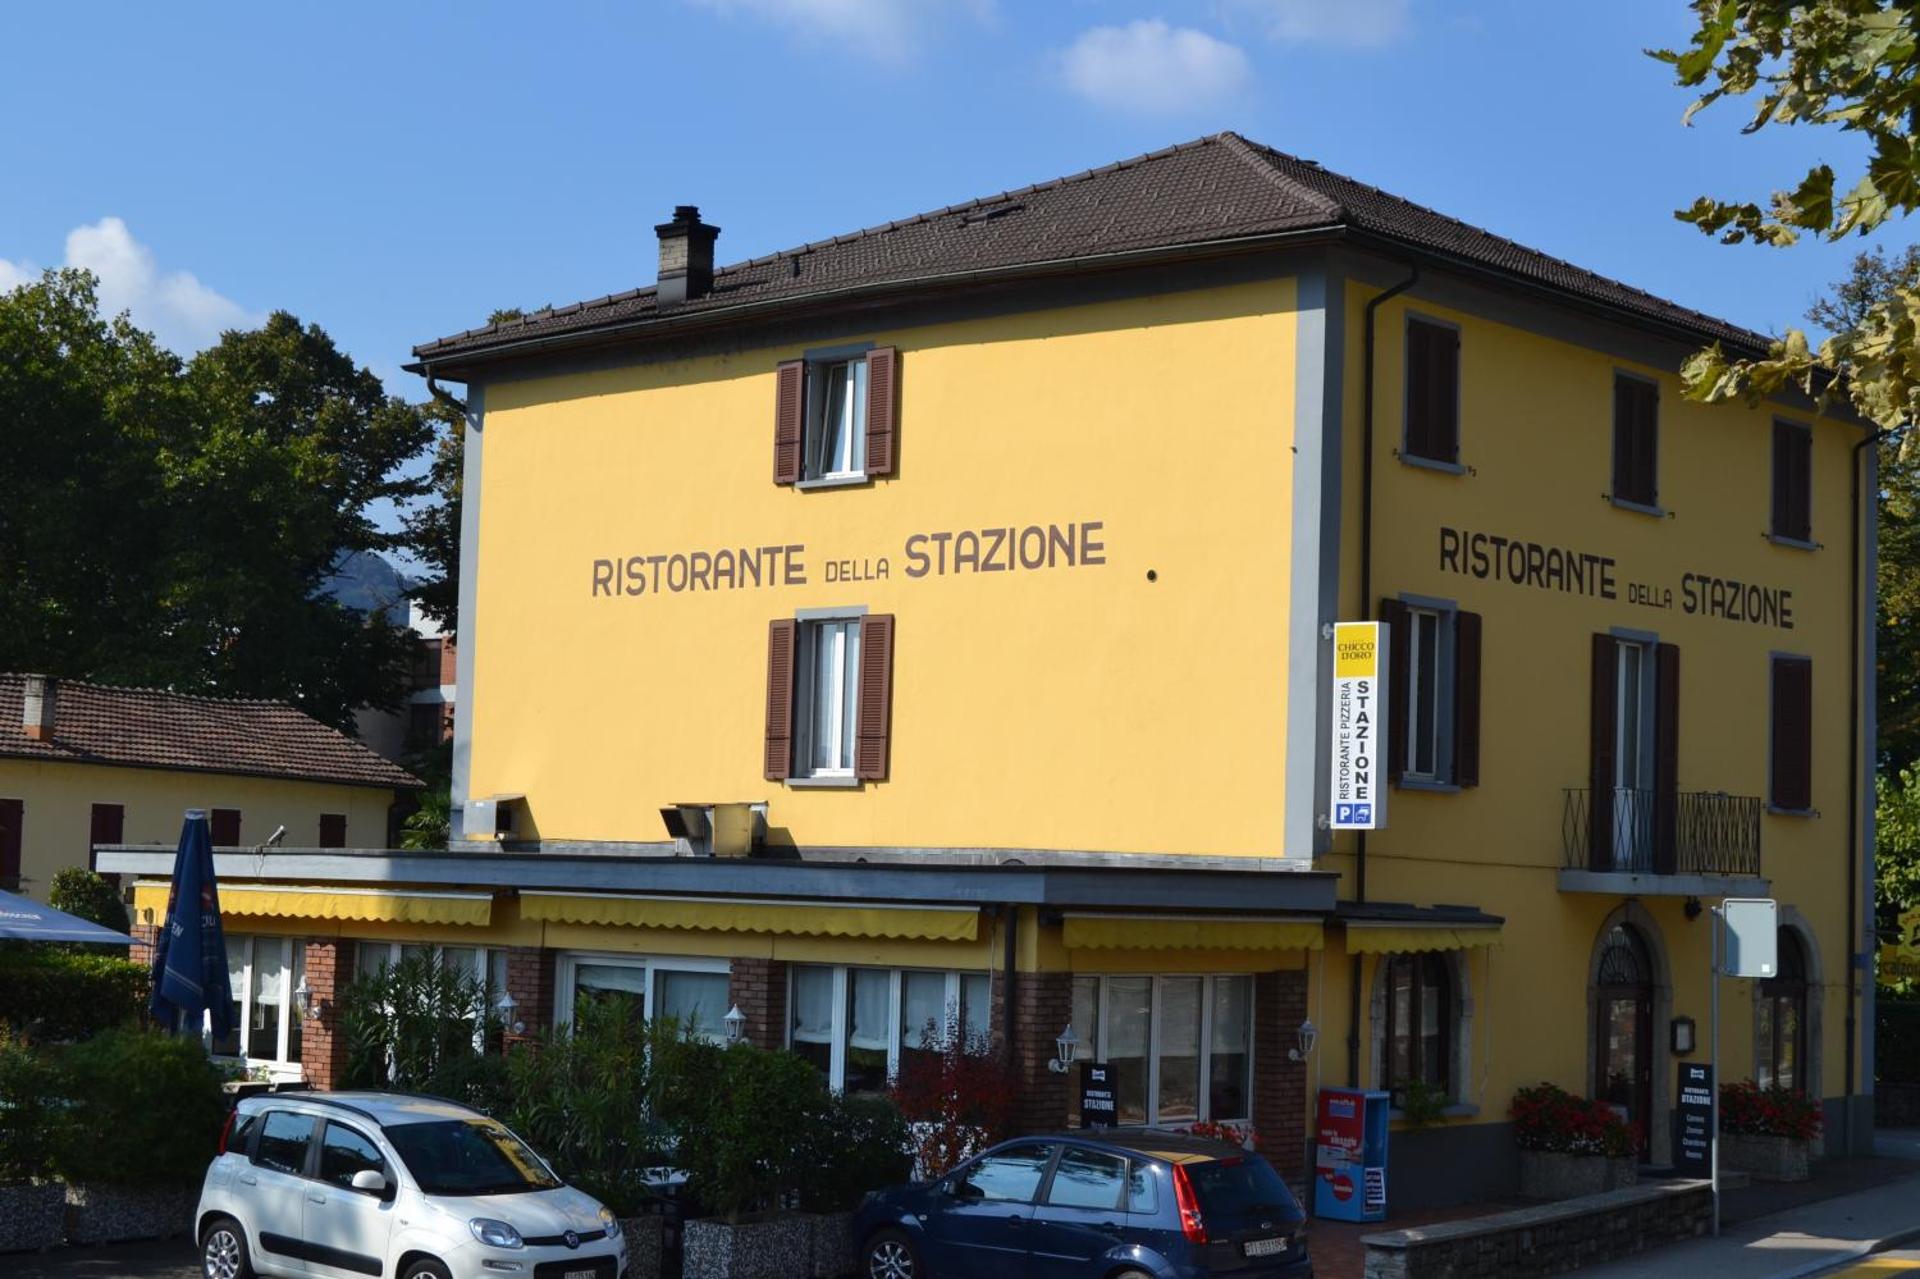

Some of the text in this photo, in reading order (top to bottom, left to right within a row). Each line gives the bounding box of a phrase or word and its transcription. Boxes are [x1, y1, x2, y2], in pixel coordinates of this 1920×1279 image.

[592, 521, 1107, 597] RISTORANTE DELLA STAZIONE
[1440, 527, 1794, 629] RISTORANTE DELLA STAZIONE
[1338, 642, 1374, 651] CHICCO
[1339, 682, 1352, 800] RISTORANTE PIZZERIA
[1355, 681, 1369, 800] STAZIONE
[1084, 1098, 1114, 1111] STAZIONE
